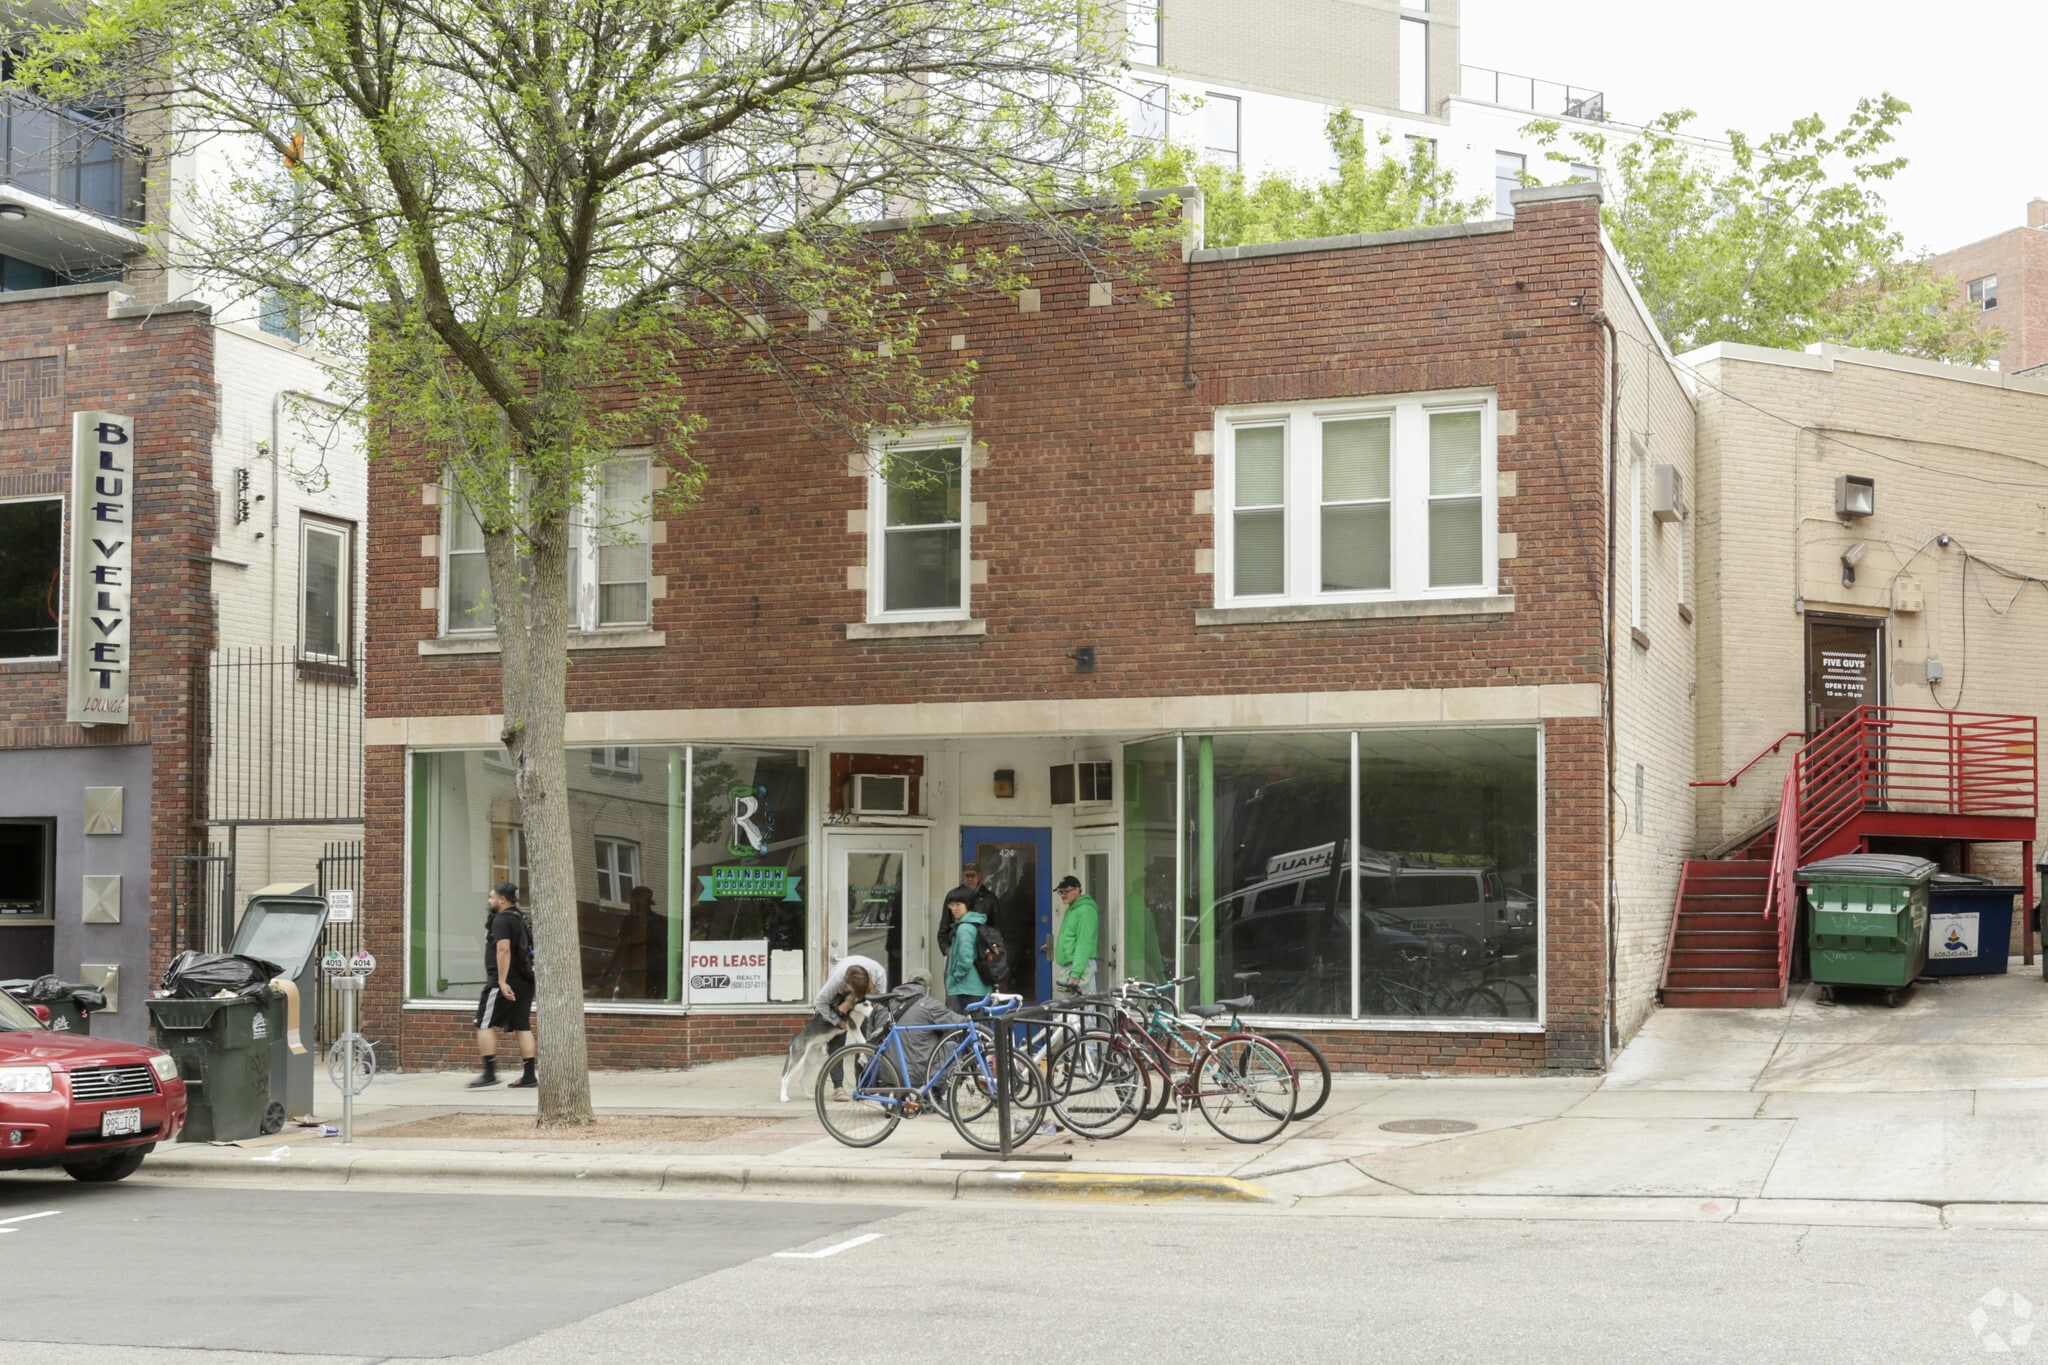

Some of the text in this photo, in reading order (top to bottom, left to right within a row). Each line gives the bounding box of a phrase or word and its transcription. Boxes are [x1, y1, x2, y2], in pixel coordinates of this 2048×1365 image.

[89, 422, 129, 690] BLUE VELVET
[1823, 658, 1865, 668] FIVE GUYS
[83, 697, 125, 714] LOUNGE
[828, 813, 850, 825] 426
[999, 848, 1015, 858] 424
[716, 869, 784, 880] RAINBOW
[716, 881, 784, 890] BOOKSTORE
[691, 954, 766, 968] FOR LEASE
